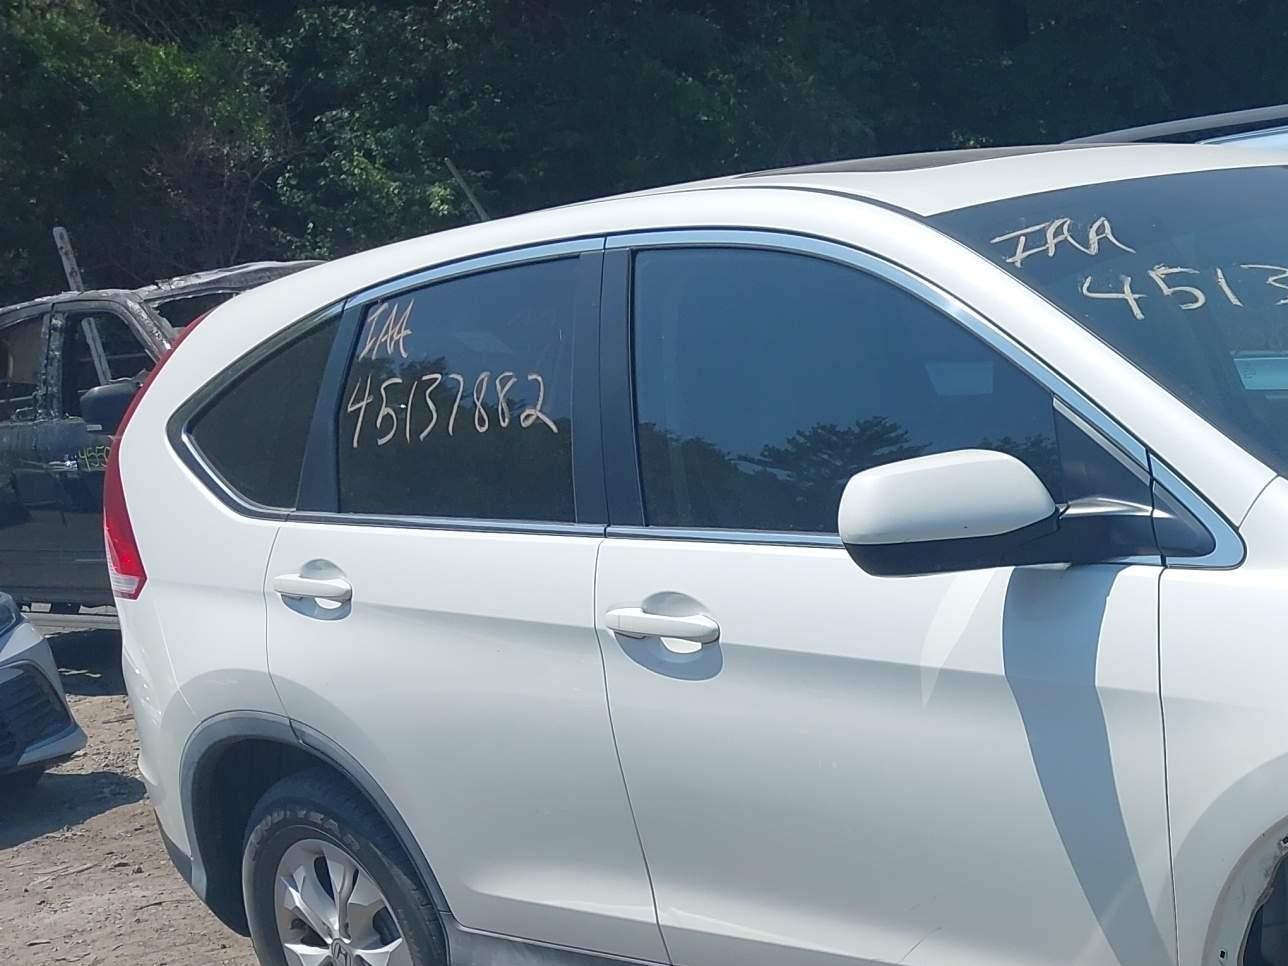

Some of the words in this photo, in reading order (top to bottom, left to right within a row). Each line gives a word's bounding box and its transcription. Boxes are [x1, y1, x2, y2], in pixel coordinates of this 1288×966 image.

[990, 217, 1136, 268] IAA
[358, 298, 412, 361] IAA
[347, 371, 559, 448] 45137882
